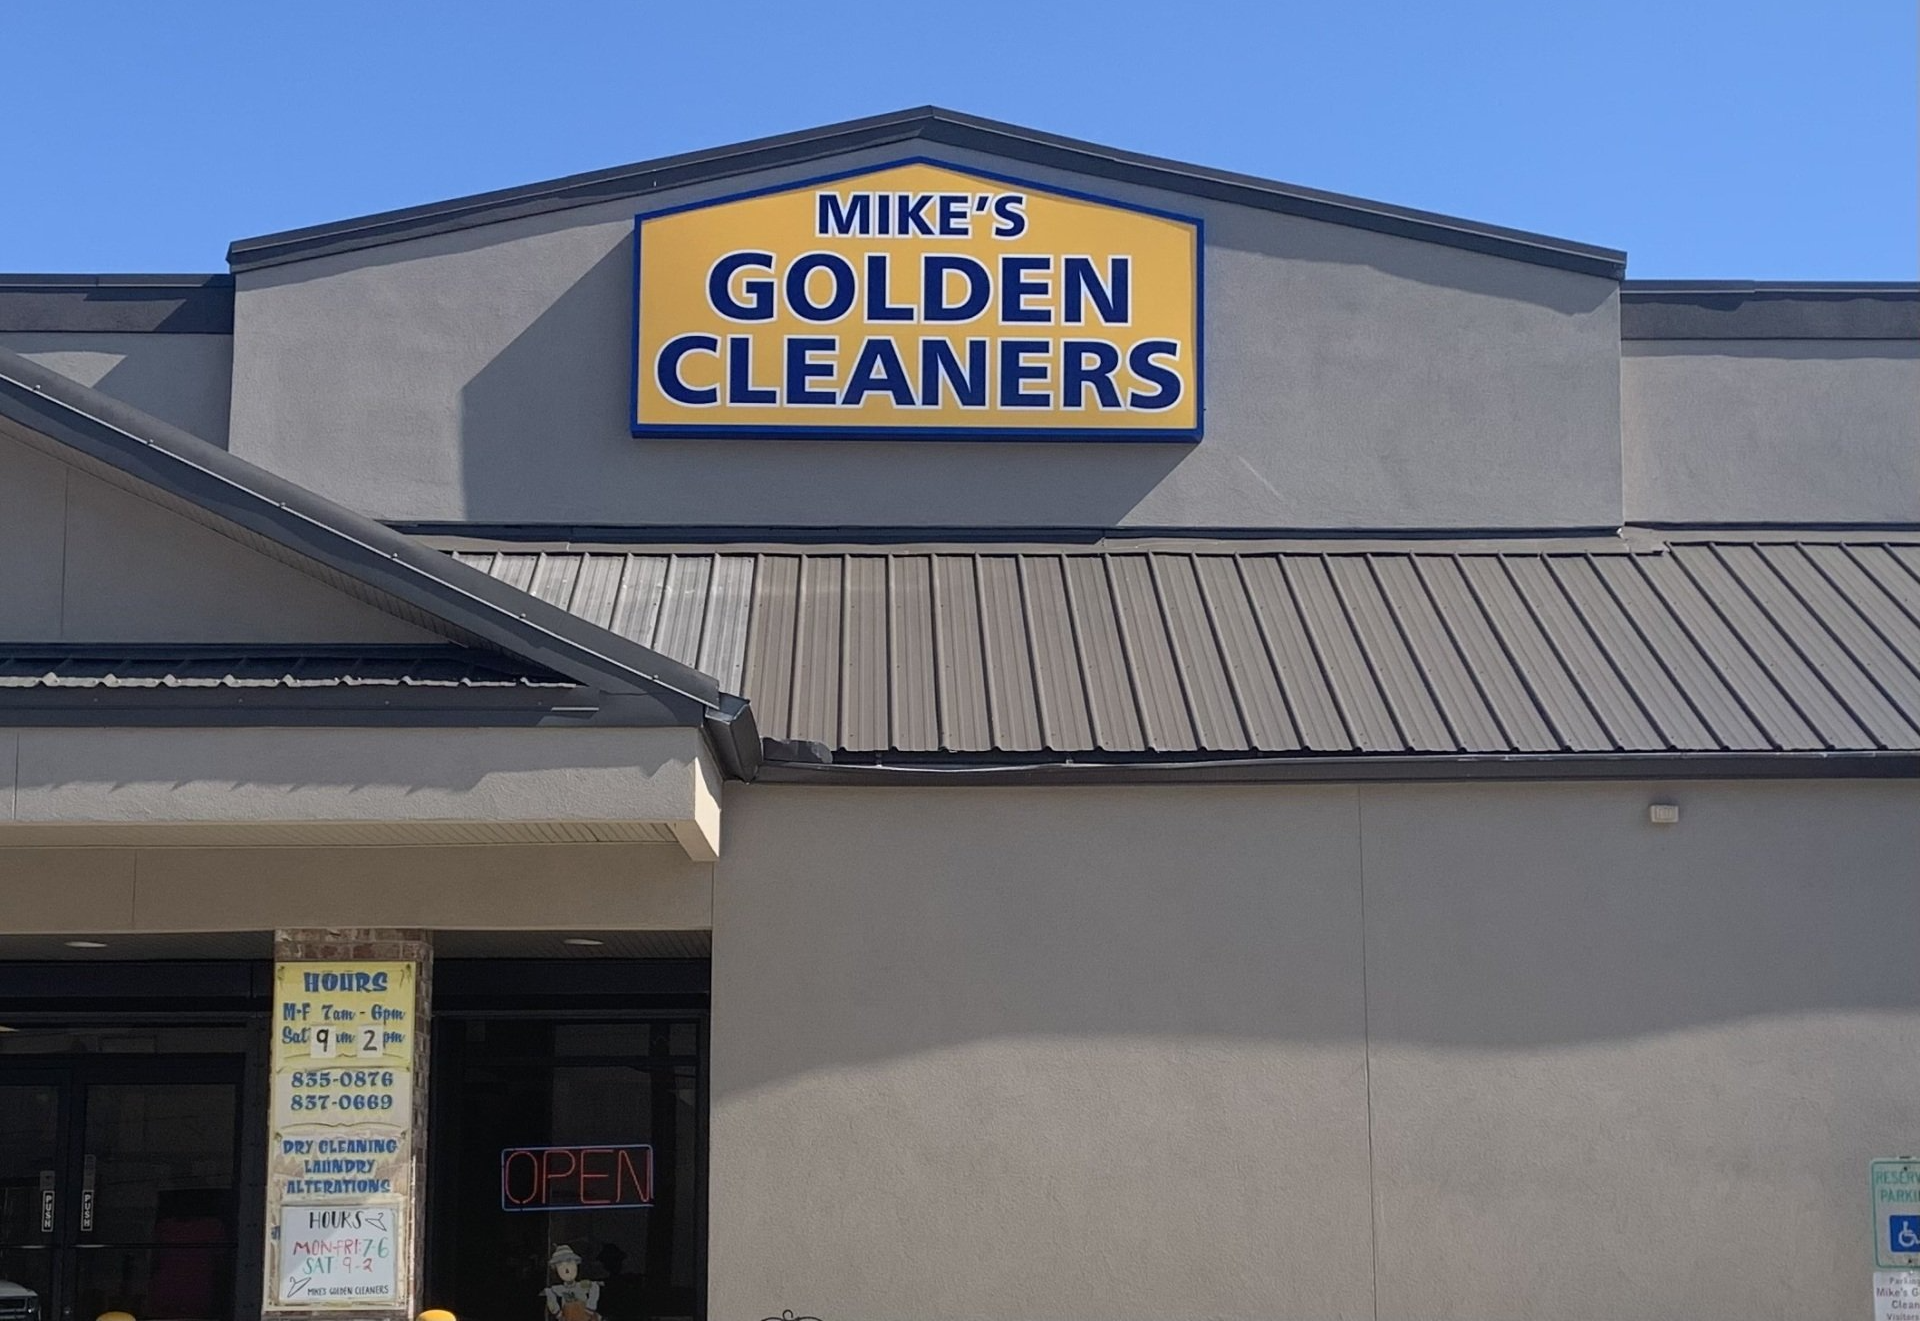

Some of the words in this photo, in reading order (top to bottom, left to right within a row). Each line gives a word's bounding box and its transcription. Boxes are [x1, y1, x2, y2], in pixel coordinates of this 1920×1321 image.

[817, 193, 1027, 238] MIKE'S
[708, 252, 1129, 323] GOLDEN
[656, 335, 1182, 411] CLEANERS
[304, 971, 388, 993] HOURS
[283, 1003, 310, 1020] M-F
[291, 1071, 393, 1088] 835-0876
[290, 1094, 393, 1110] 837-0669
[283, 1139, 313, 1154] DRY
[318, 1139, 398, 1154] CLEANING
[304, 1159, 375, 1173] LAUNDRY
[505, 1149, 651, 1205] OPEN
[287, 1179, 391, 1194] ALTERATIONS
